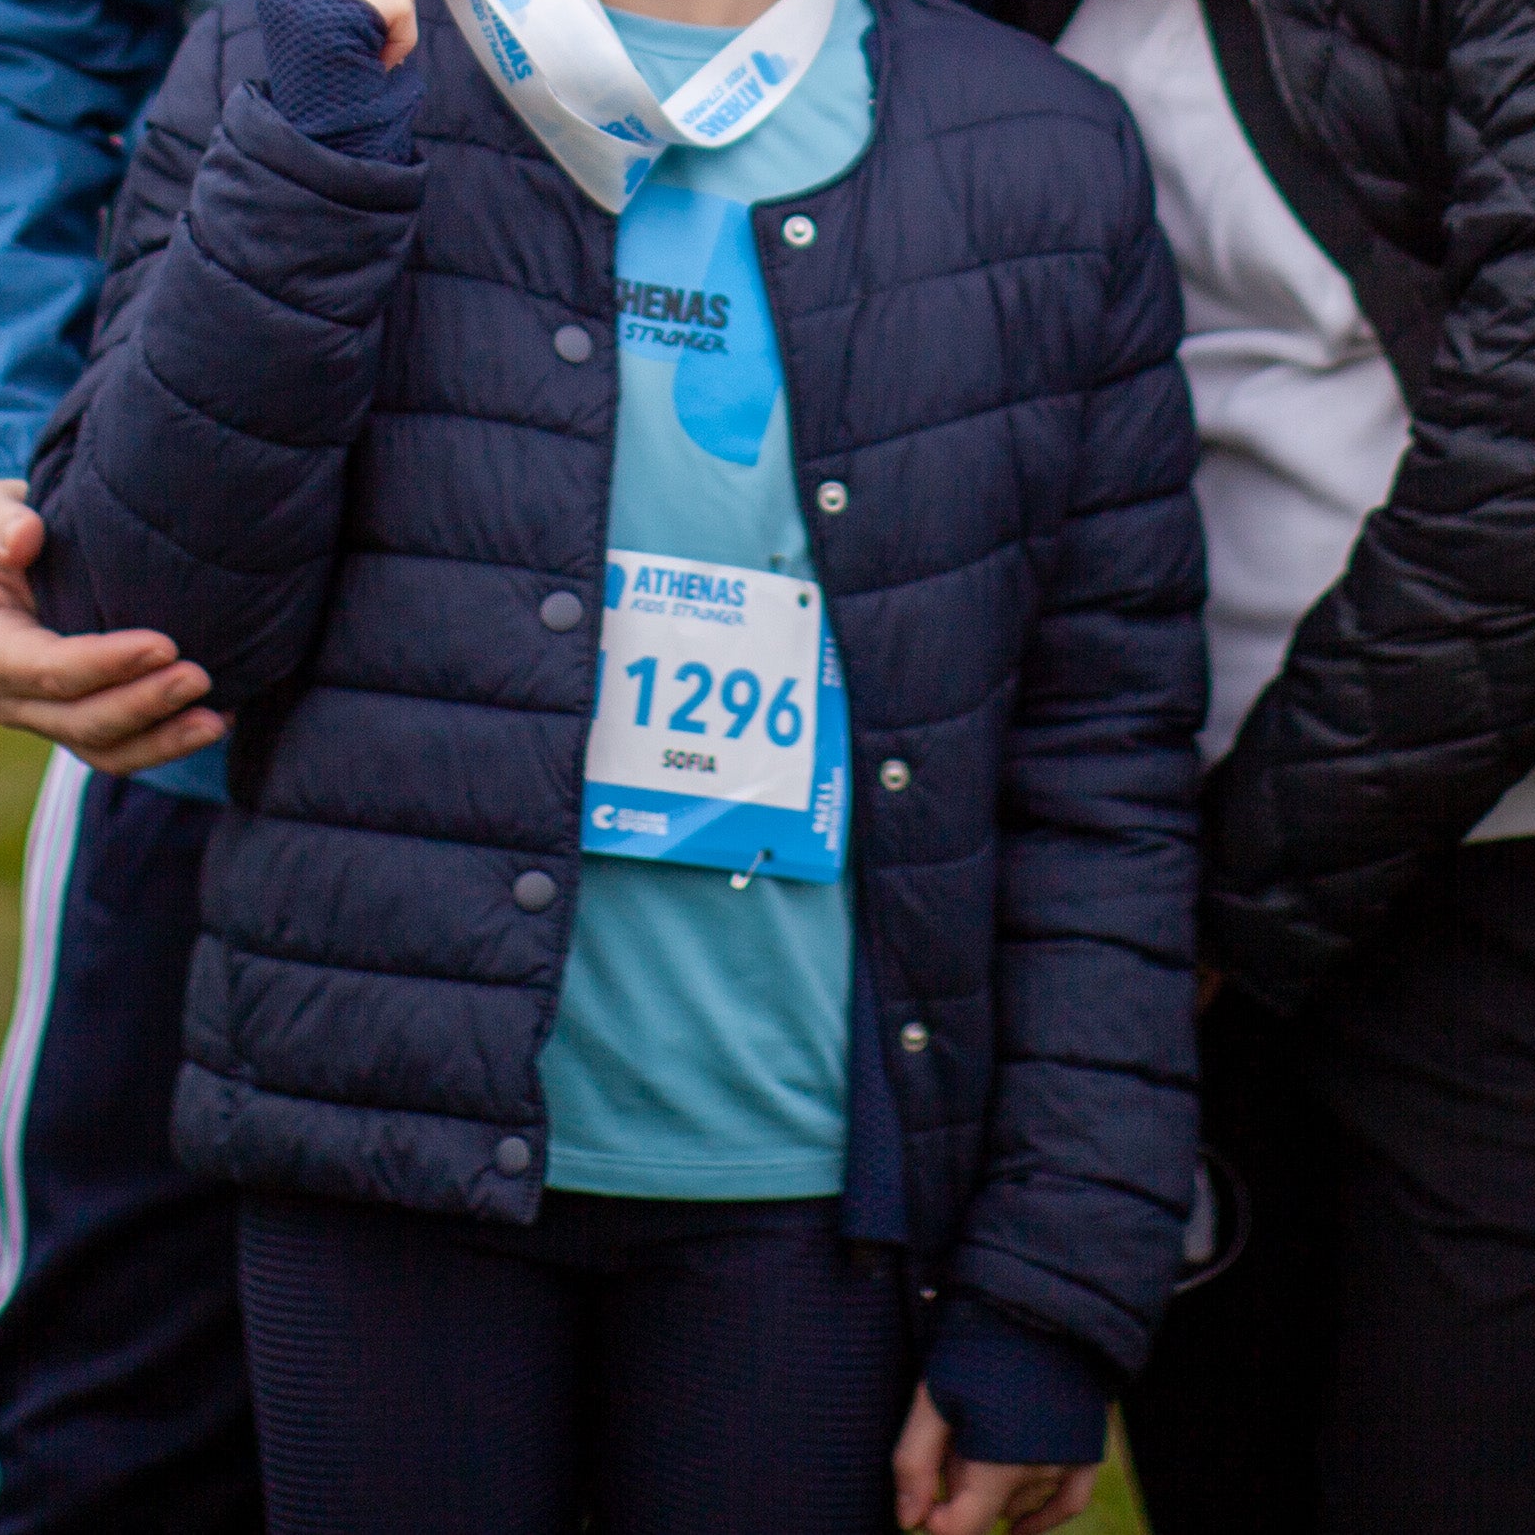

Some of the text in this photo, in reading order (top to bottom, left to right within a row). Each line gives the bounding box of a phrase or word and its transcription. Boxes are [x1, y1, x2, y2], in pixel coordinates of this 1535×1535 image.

[695, 75, 765, 138] ATHENAS
[616, 276, 731, 330] HENAS
[626, 322, 729, 356] STRONGER
[632, 565, 747, 608] ATHENAS
[624, 655, 803, 748] 1296
[662, 749, 717, 774] SOFIA
